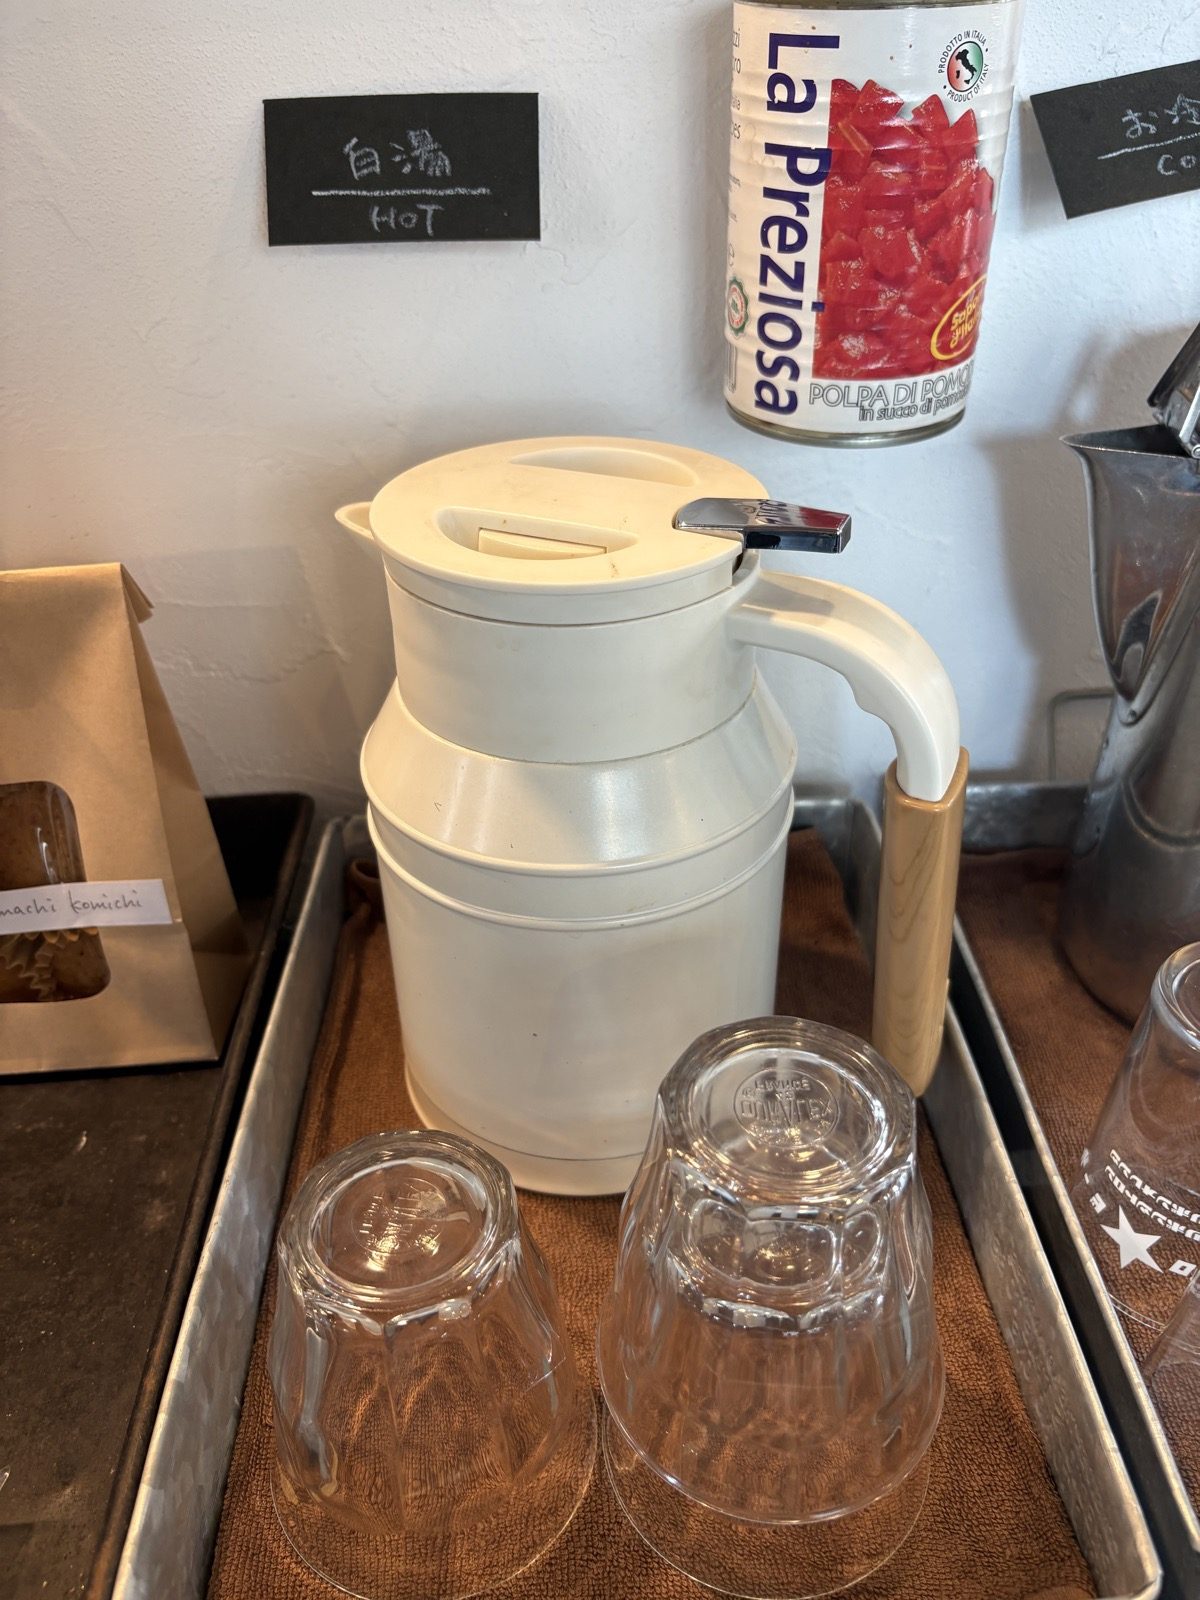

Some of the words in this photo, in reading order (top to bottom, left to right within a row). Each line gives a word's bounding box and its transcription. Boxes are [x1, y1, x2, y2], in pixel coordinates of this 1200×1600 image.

[938, 33, 963, 74] PRODOTTO
[964, 30, 971, 39] IN
[971, 30, 987, 46] ITALIA
[766, 33, 841, 113] La
[946, 89, 974, 103] PRODUCT
[973, 82, 981, 95] OF
[979, 63, 990, 84] ITALY
[754, 142, 833, 417] Preziosa
[808, 382, 890, 409] POLPA
[893, 381, 917, 406] DI
[858, 405, 875, 422] in
[876, 404, 919, 421] succo
[919, 397, 933, 415] di
[67, 889, 143, 914] komichi
